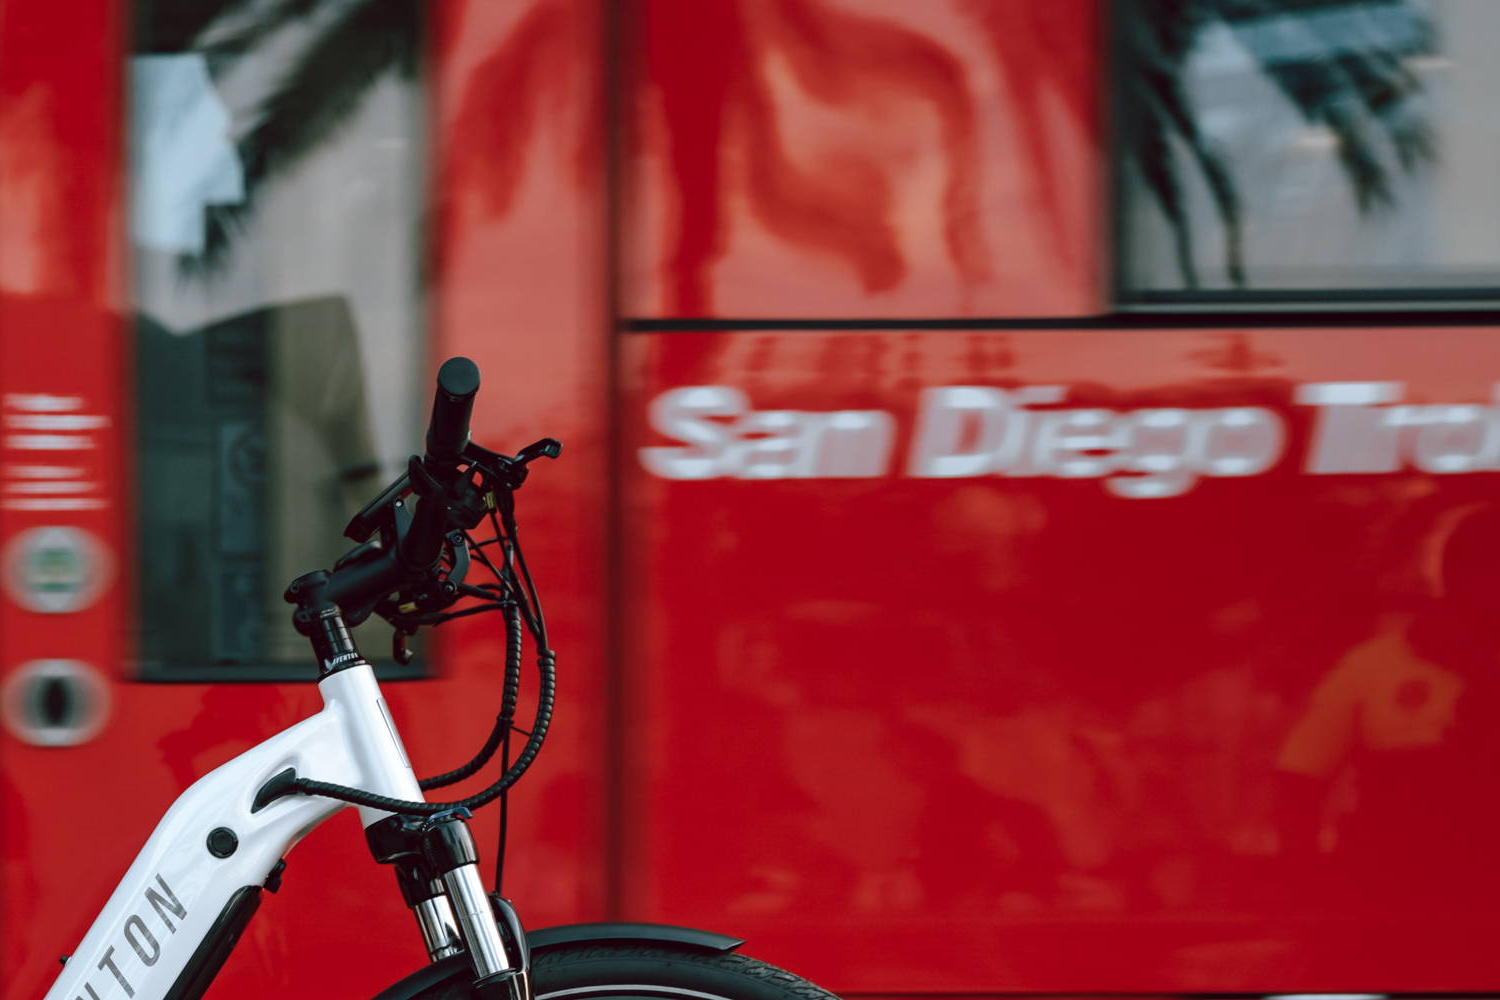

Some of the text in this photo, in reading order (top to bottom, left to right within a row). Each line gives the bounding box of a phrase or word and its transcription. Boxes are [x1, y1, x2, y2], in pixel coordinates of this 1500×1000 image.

[639, 381, 1500, 498] San Diego Tro
